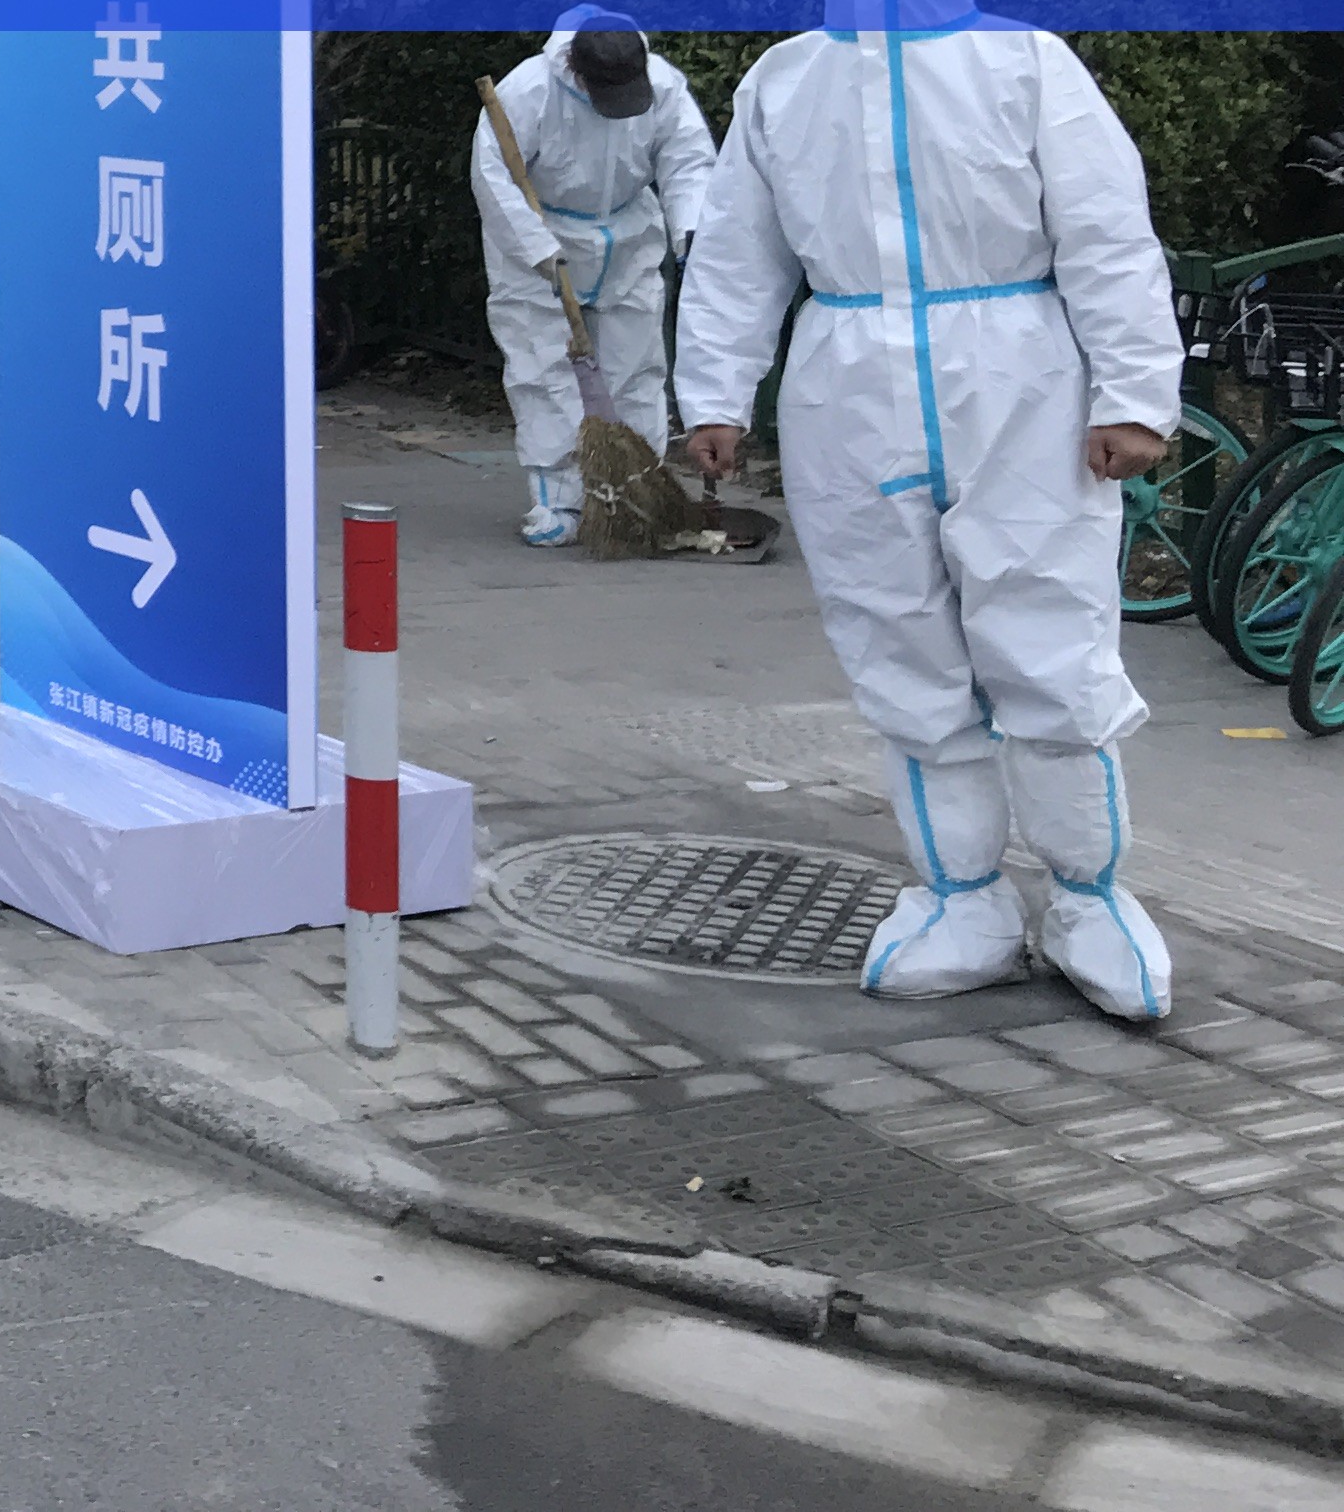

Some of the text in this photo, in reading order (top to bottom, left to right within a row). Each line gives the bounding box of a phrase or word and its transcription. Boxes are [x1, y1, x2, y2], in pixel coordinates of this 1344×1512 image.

[49, 681, 224, 764] 张江镇新冠疫情防控办
